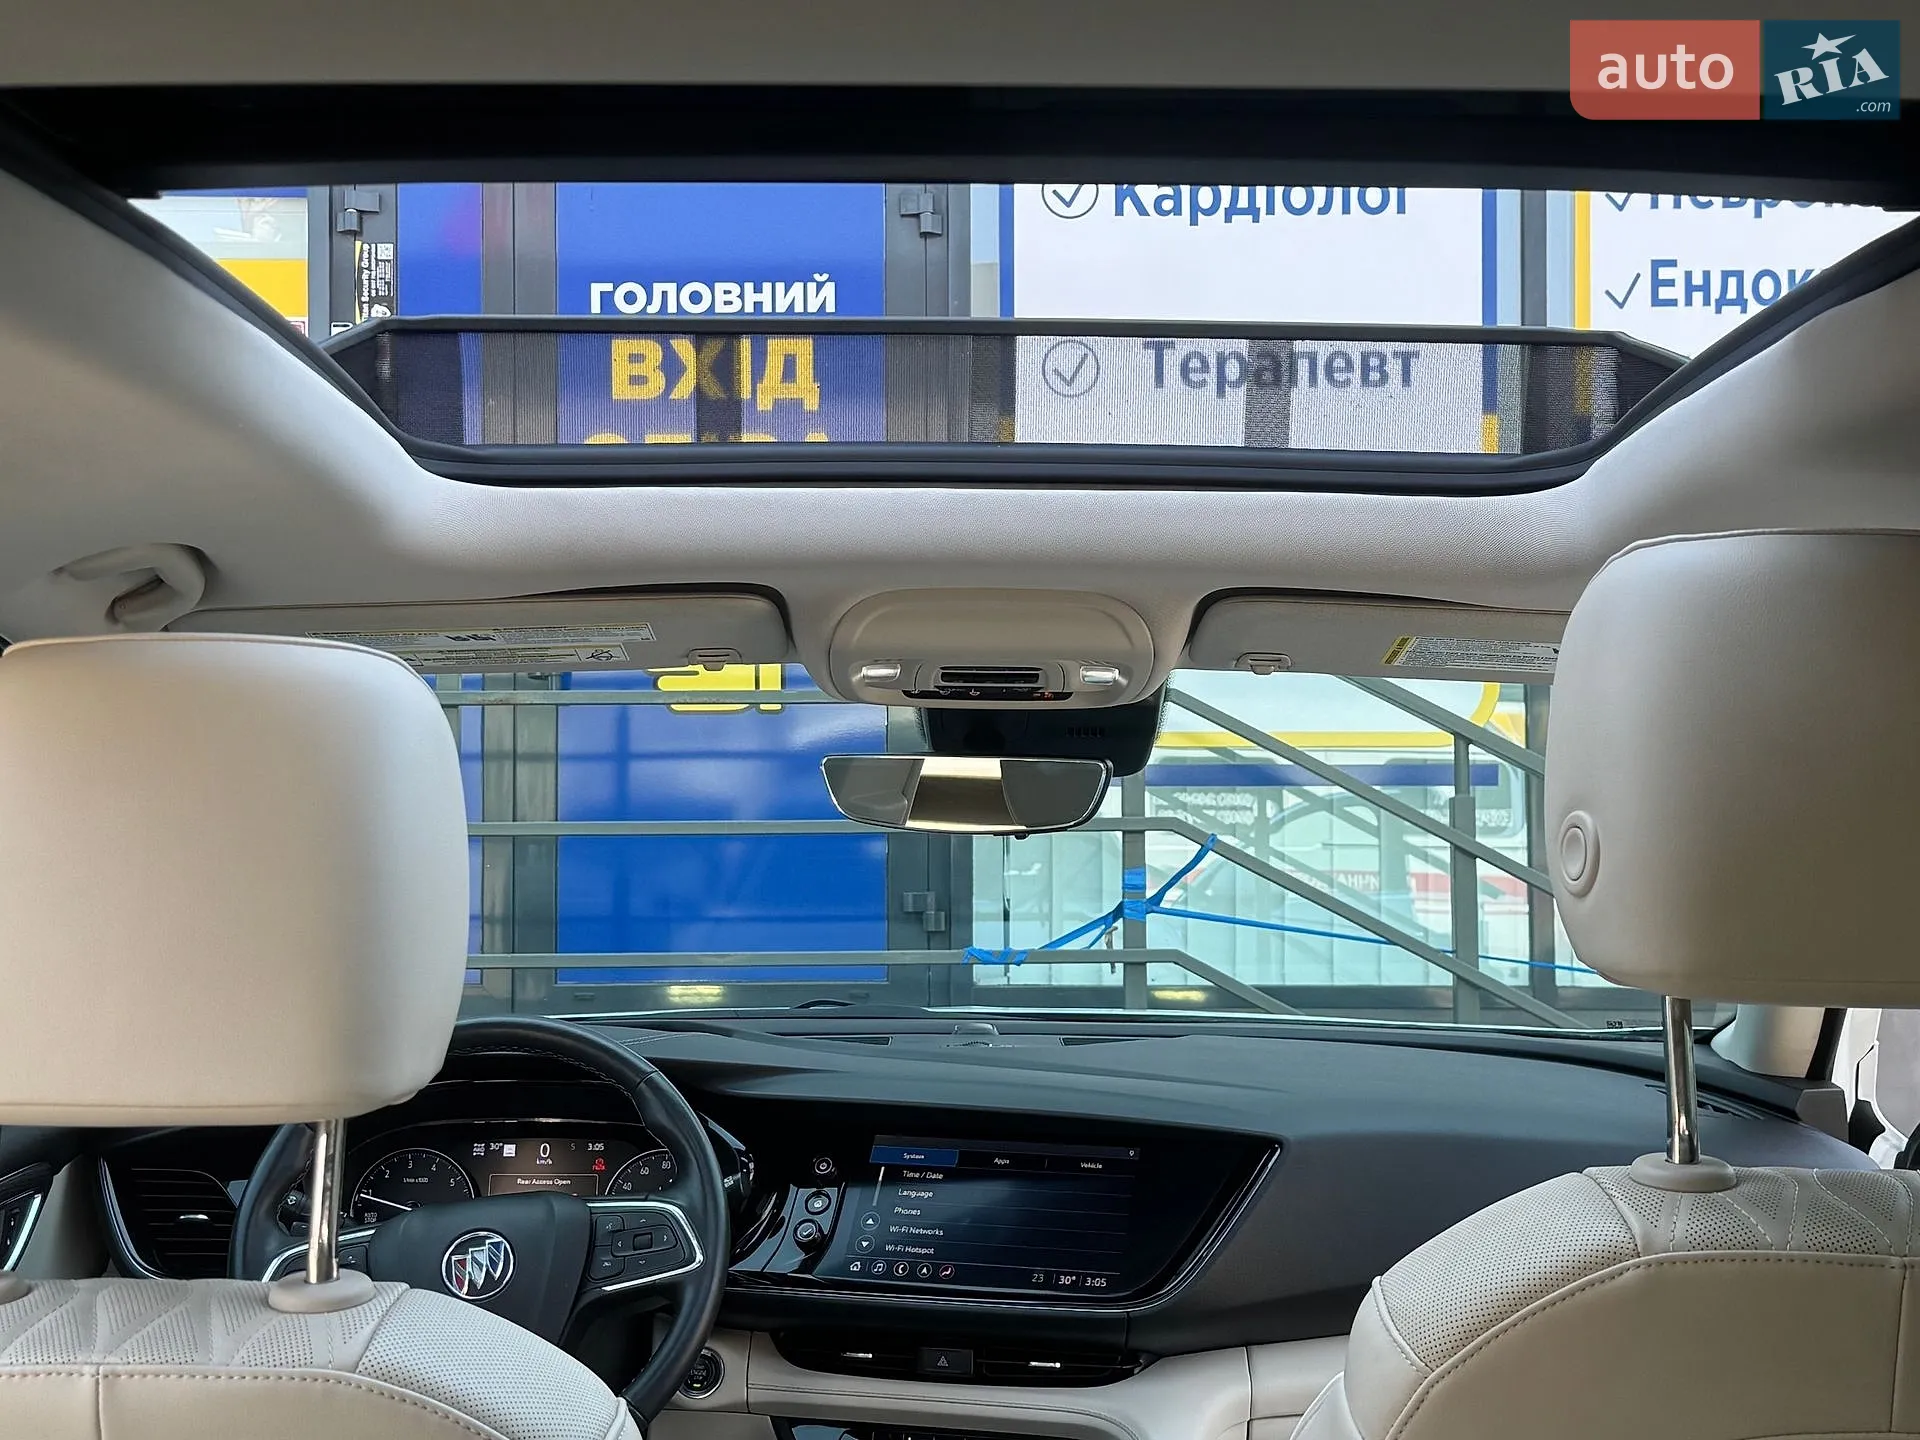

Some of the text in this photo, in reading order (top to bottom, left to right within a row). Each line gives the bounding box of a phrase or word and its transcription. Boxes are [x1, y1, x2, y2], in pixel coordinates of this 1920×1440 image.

[590, 272, 836, 314] ГОЛОВНИЙ
[1143, 339, 1420, 399] Терапевт
[611, 338, 820, 411] ВХІД
[539, 1142, 551, 1158] 0
[587, 1142, 605, 1151] 3:05
[407, 1160, 413, 1169] 3
[993, 1157, 1010, 1165] Apps
[384, 1169, 390, 1179] 2
[639, 1166, 650, 1175] 60
[903, 1170, 920, 1178] Time
[926, 1171, 944, 1180] Date
[554, 1178, 571, 1186] Open
[622, 1182, 633, 1191] 40
[898, 1188, 934, 1199] Language
[894, 1206, 921, 1216] Phones
[889, 1224, 944, 1236] Wi-Fi Networks
[885, 1243, 935, 1255] Wi-Fi Hotspot
[1031, 1273, 1045, 1283] 23
[1084, 1277, 1108, 1288] 3:05
